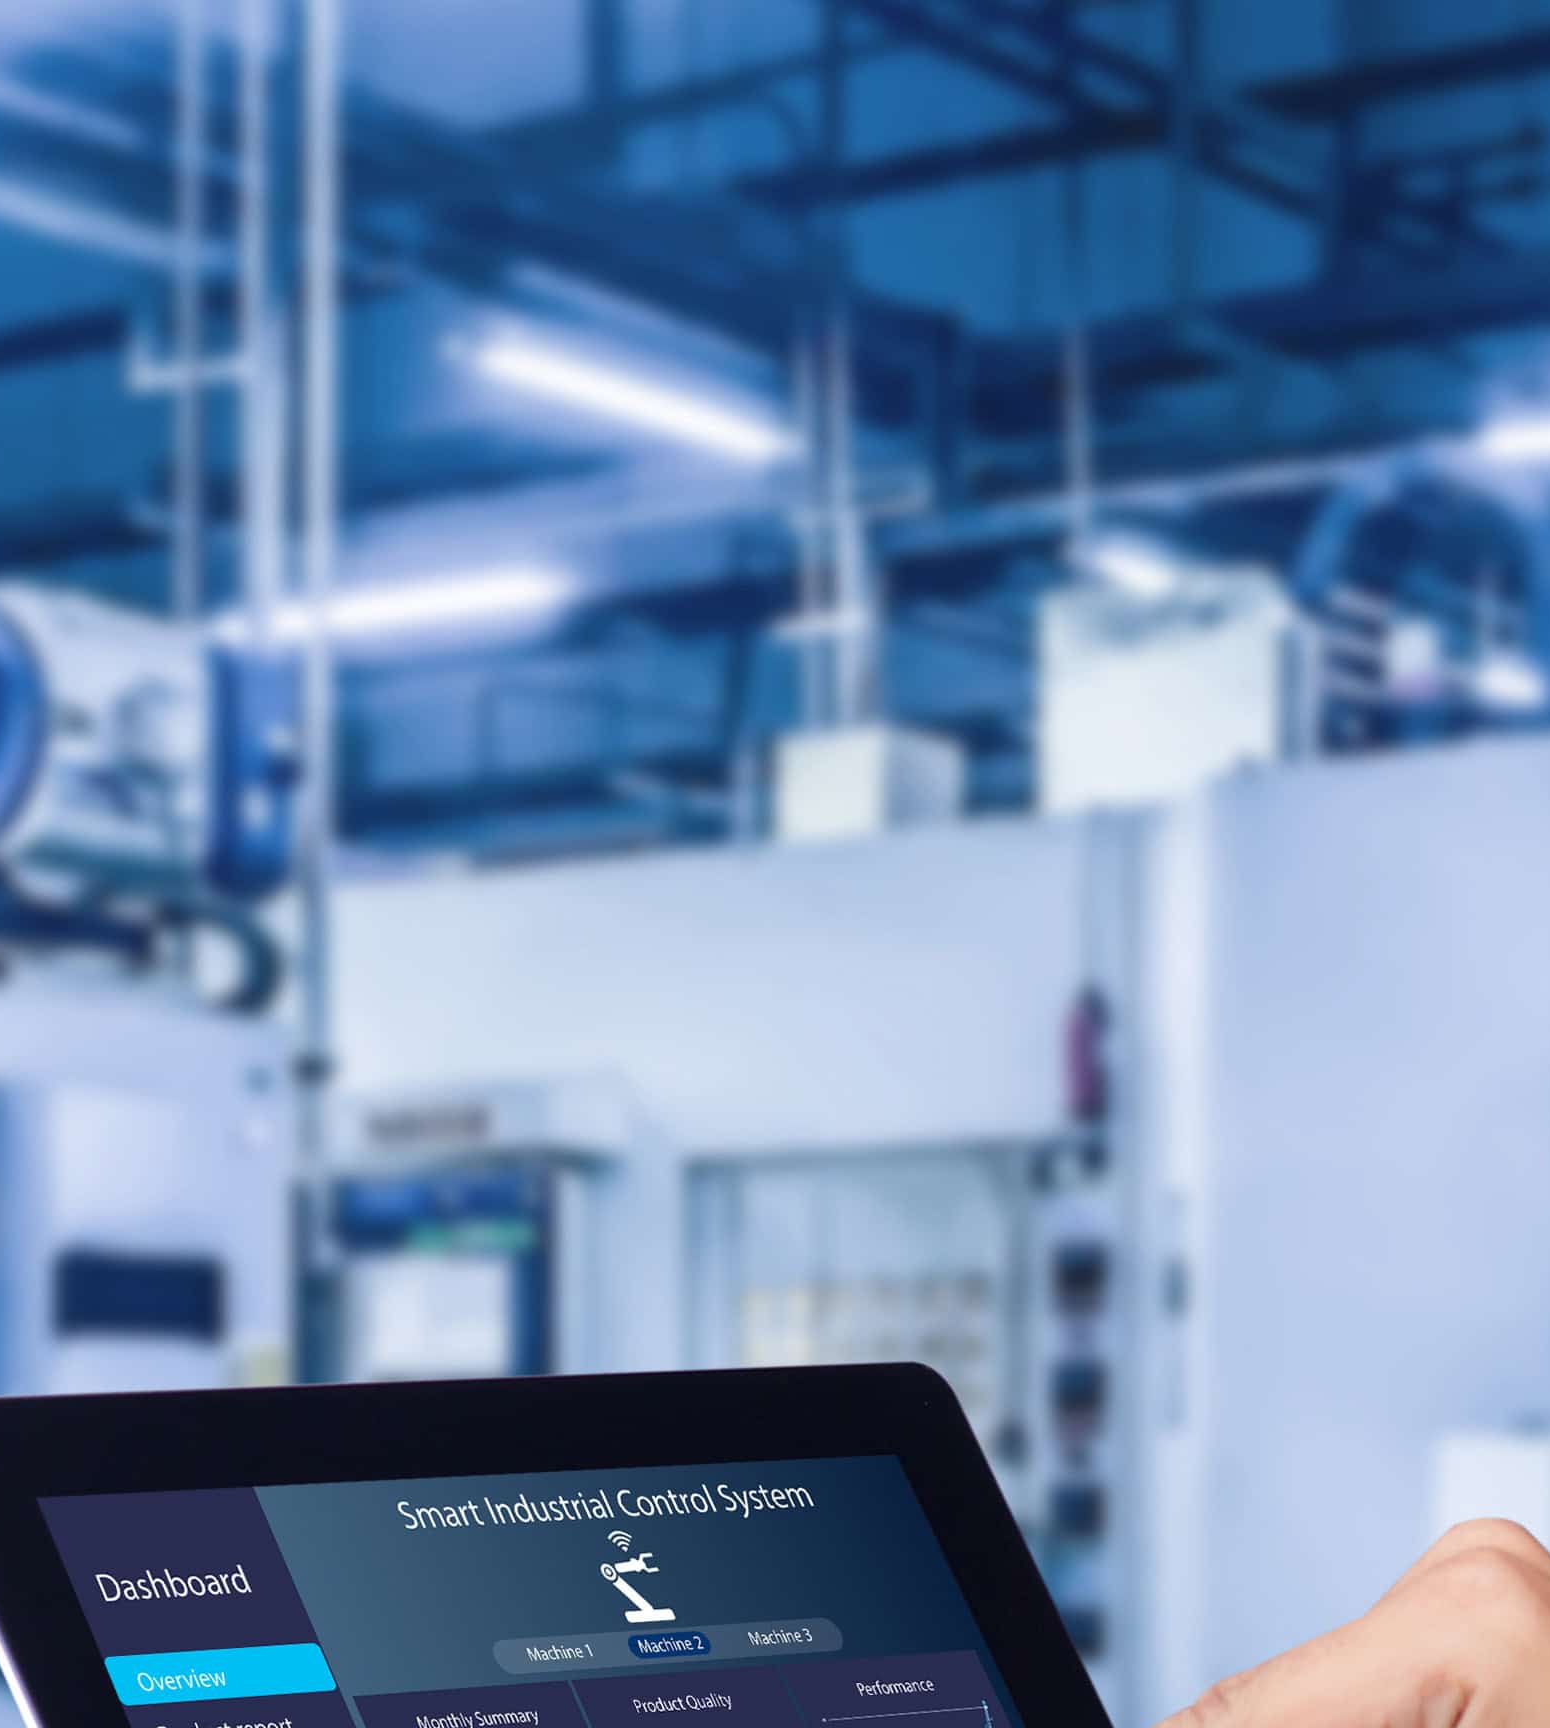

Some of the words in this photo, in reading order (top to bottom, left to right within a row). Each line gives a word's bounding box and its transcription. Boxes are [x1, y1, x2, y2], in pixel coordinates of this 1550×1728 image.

[397, 1499, 485, 1530] Smart
[483, 1489, 615, 1525] Industrial
[616, 1483, 717, 1517] Control
[716, 1483, 815, 1519] System
[95, 1564, 253, 1602] Dashboard
[637, 1634, 695, 1653] Machine
[693, 1635, 705, 1650] 2
[747, 1628, 803, 1646] Machine
[802, 1627, 813, 1642] 3
[526, 1644, 584, 1662] Machine
[584, 1643, 594, 1657] 1
[136, 1668, 227, 1692] Overview
[855, 1678, 935, 1697] Performance
[632, 1696, 687, 1714] Product
[685, 1693, 732, 1711] Quality
[474, 1711, 539, 1727] Summary
